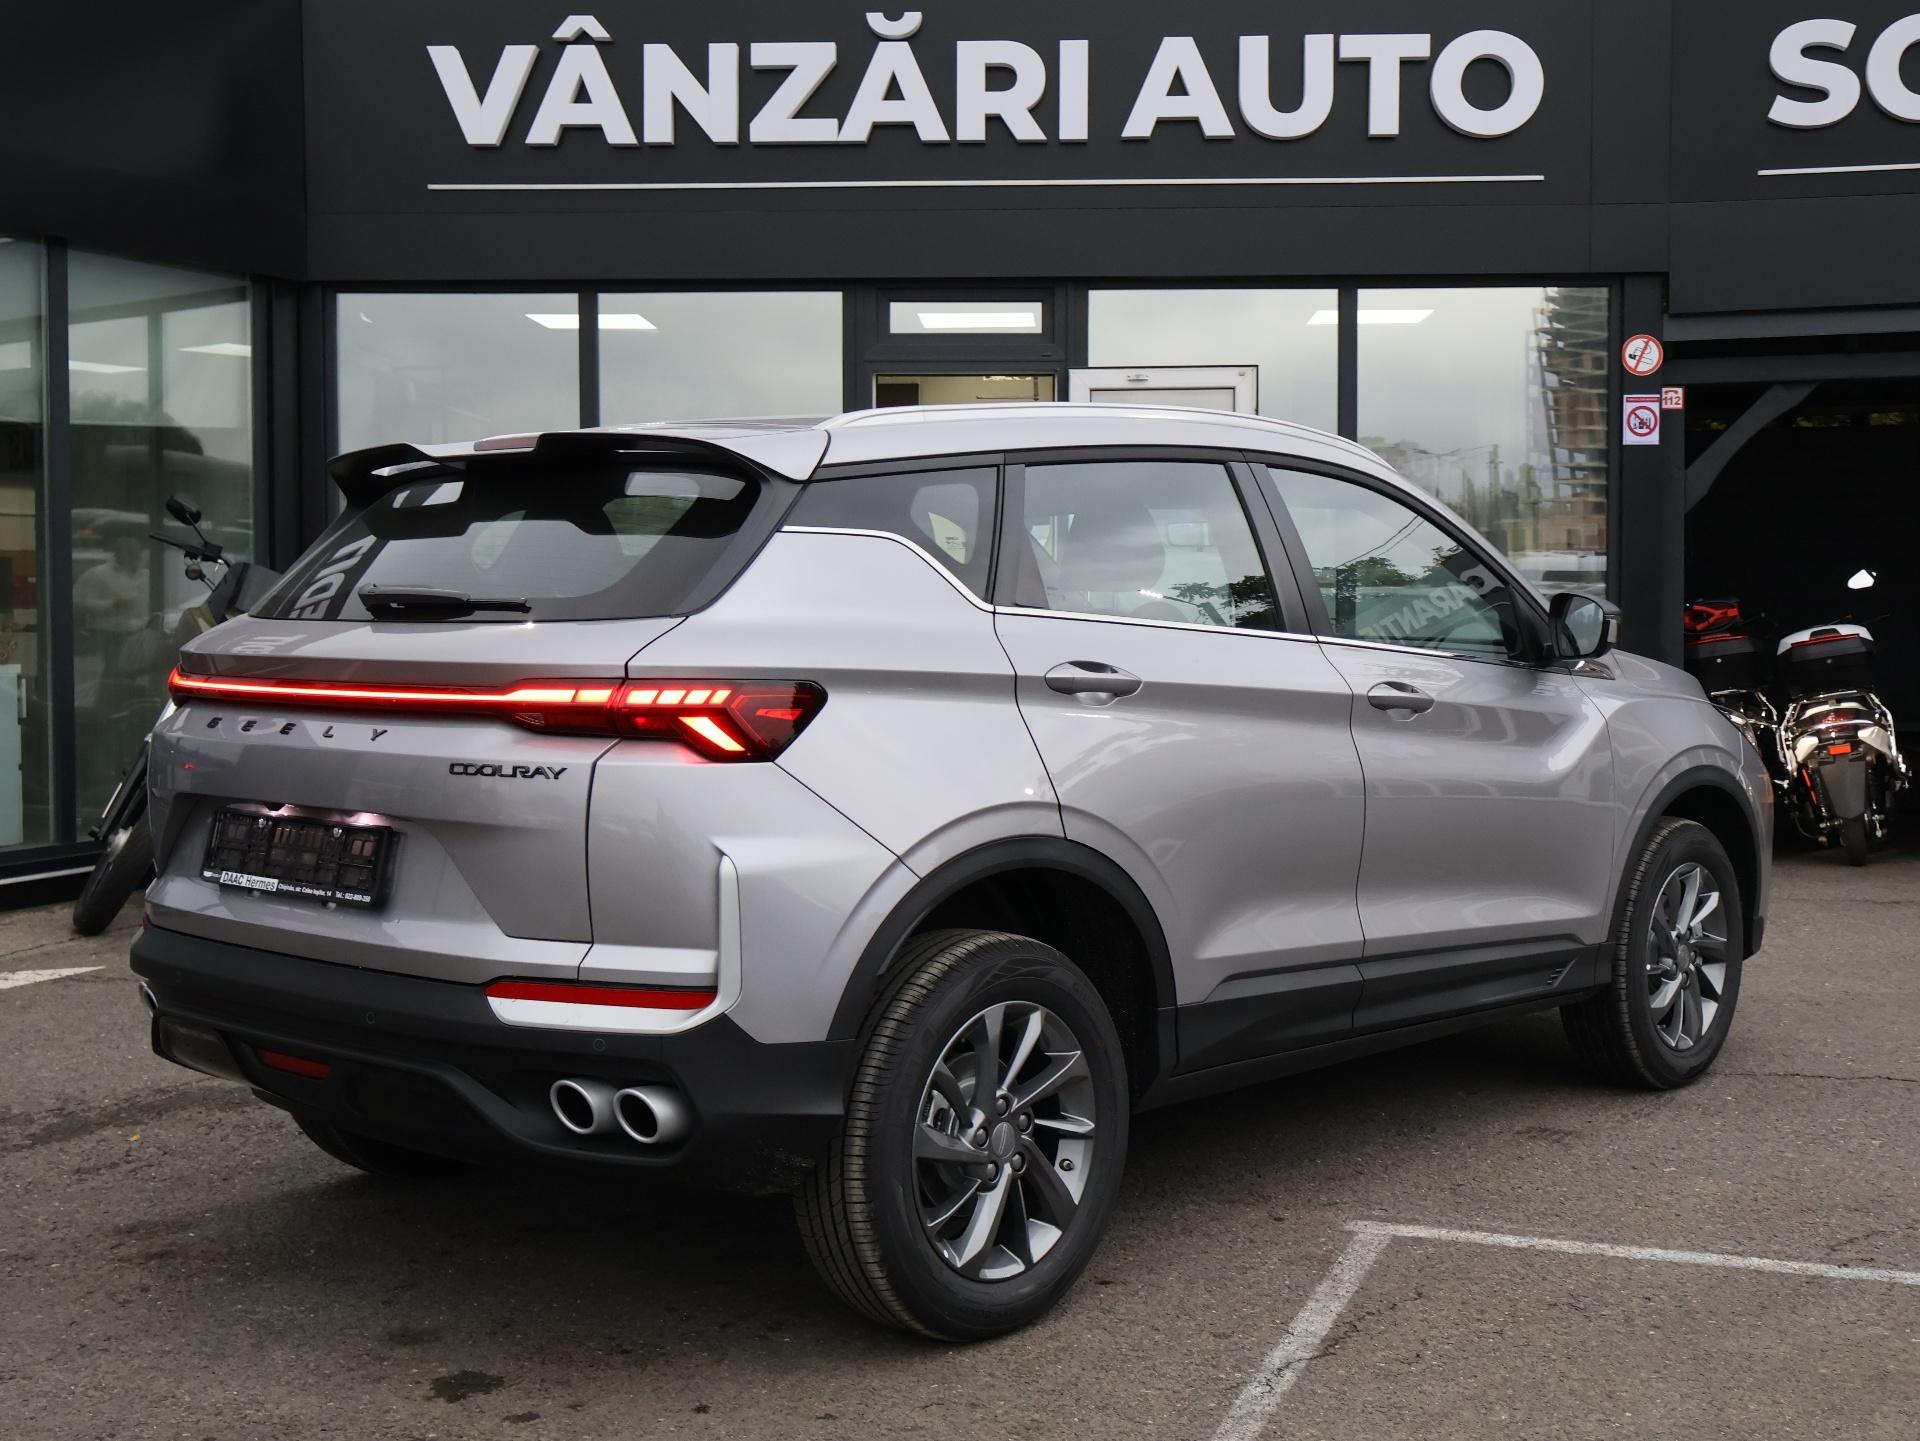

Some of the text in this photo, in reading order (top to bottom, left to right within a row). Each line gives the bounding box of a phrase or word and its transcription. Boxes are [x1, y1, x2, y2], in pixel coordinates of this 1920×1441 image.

[426, 11, 1545, 147] VÂNZĂRI AUTO
[1662, 395, 1682, 406] 112
[206, 716, 388, 742] GEELY
[448, 762, 568, 780] COOLRAY
[222, 872, 244, 885] DAAC
[245, 876, 276, 891] Hermes
